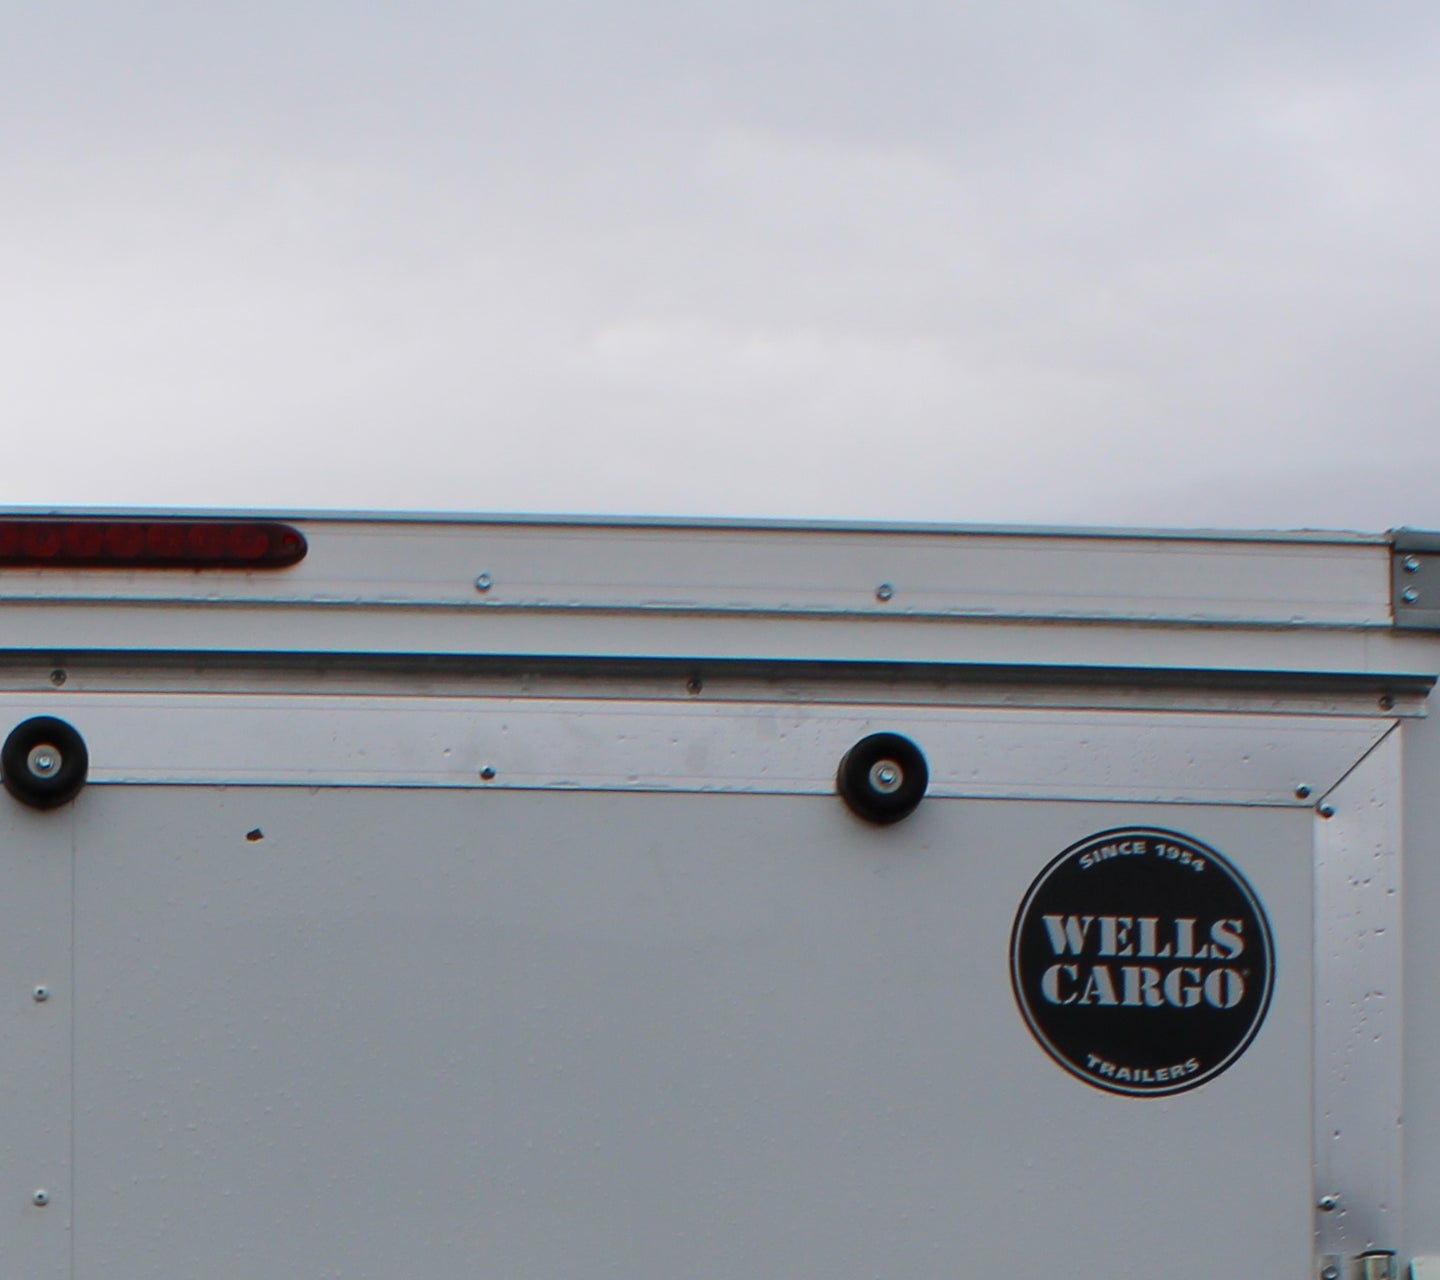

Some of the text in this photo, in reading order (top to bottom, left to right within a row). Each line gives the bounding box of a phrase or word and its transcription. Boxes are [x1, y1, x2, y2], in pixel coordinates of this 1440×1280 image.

[1078, 841, 1206, 872] SINCE 1954
[1041, 914, 1245, 960] WELLS
[1040, 964, 1245, 1009] CARGO
[1087, 1053, 1200, 1083] TRAILERS
